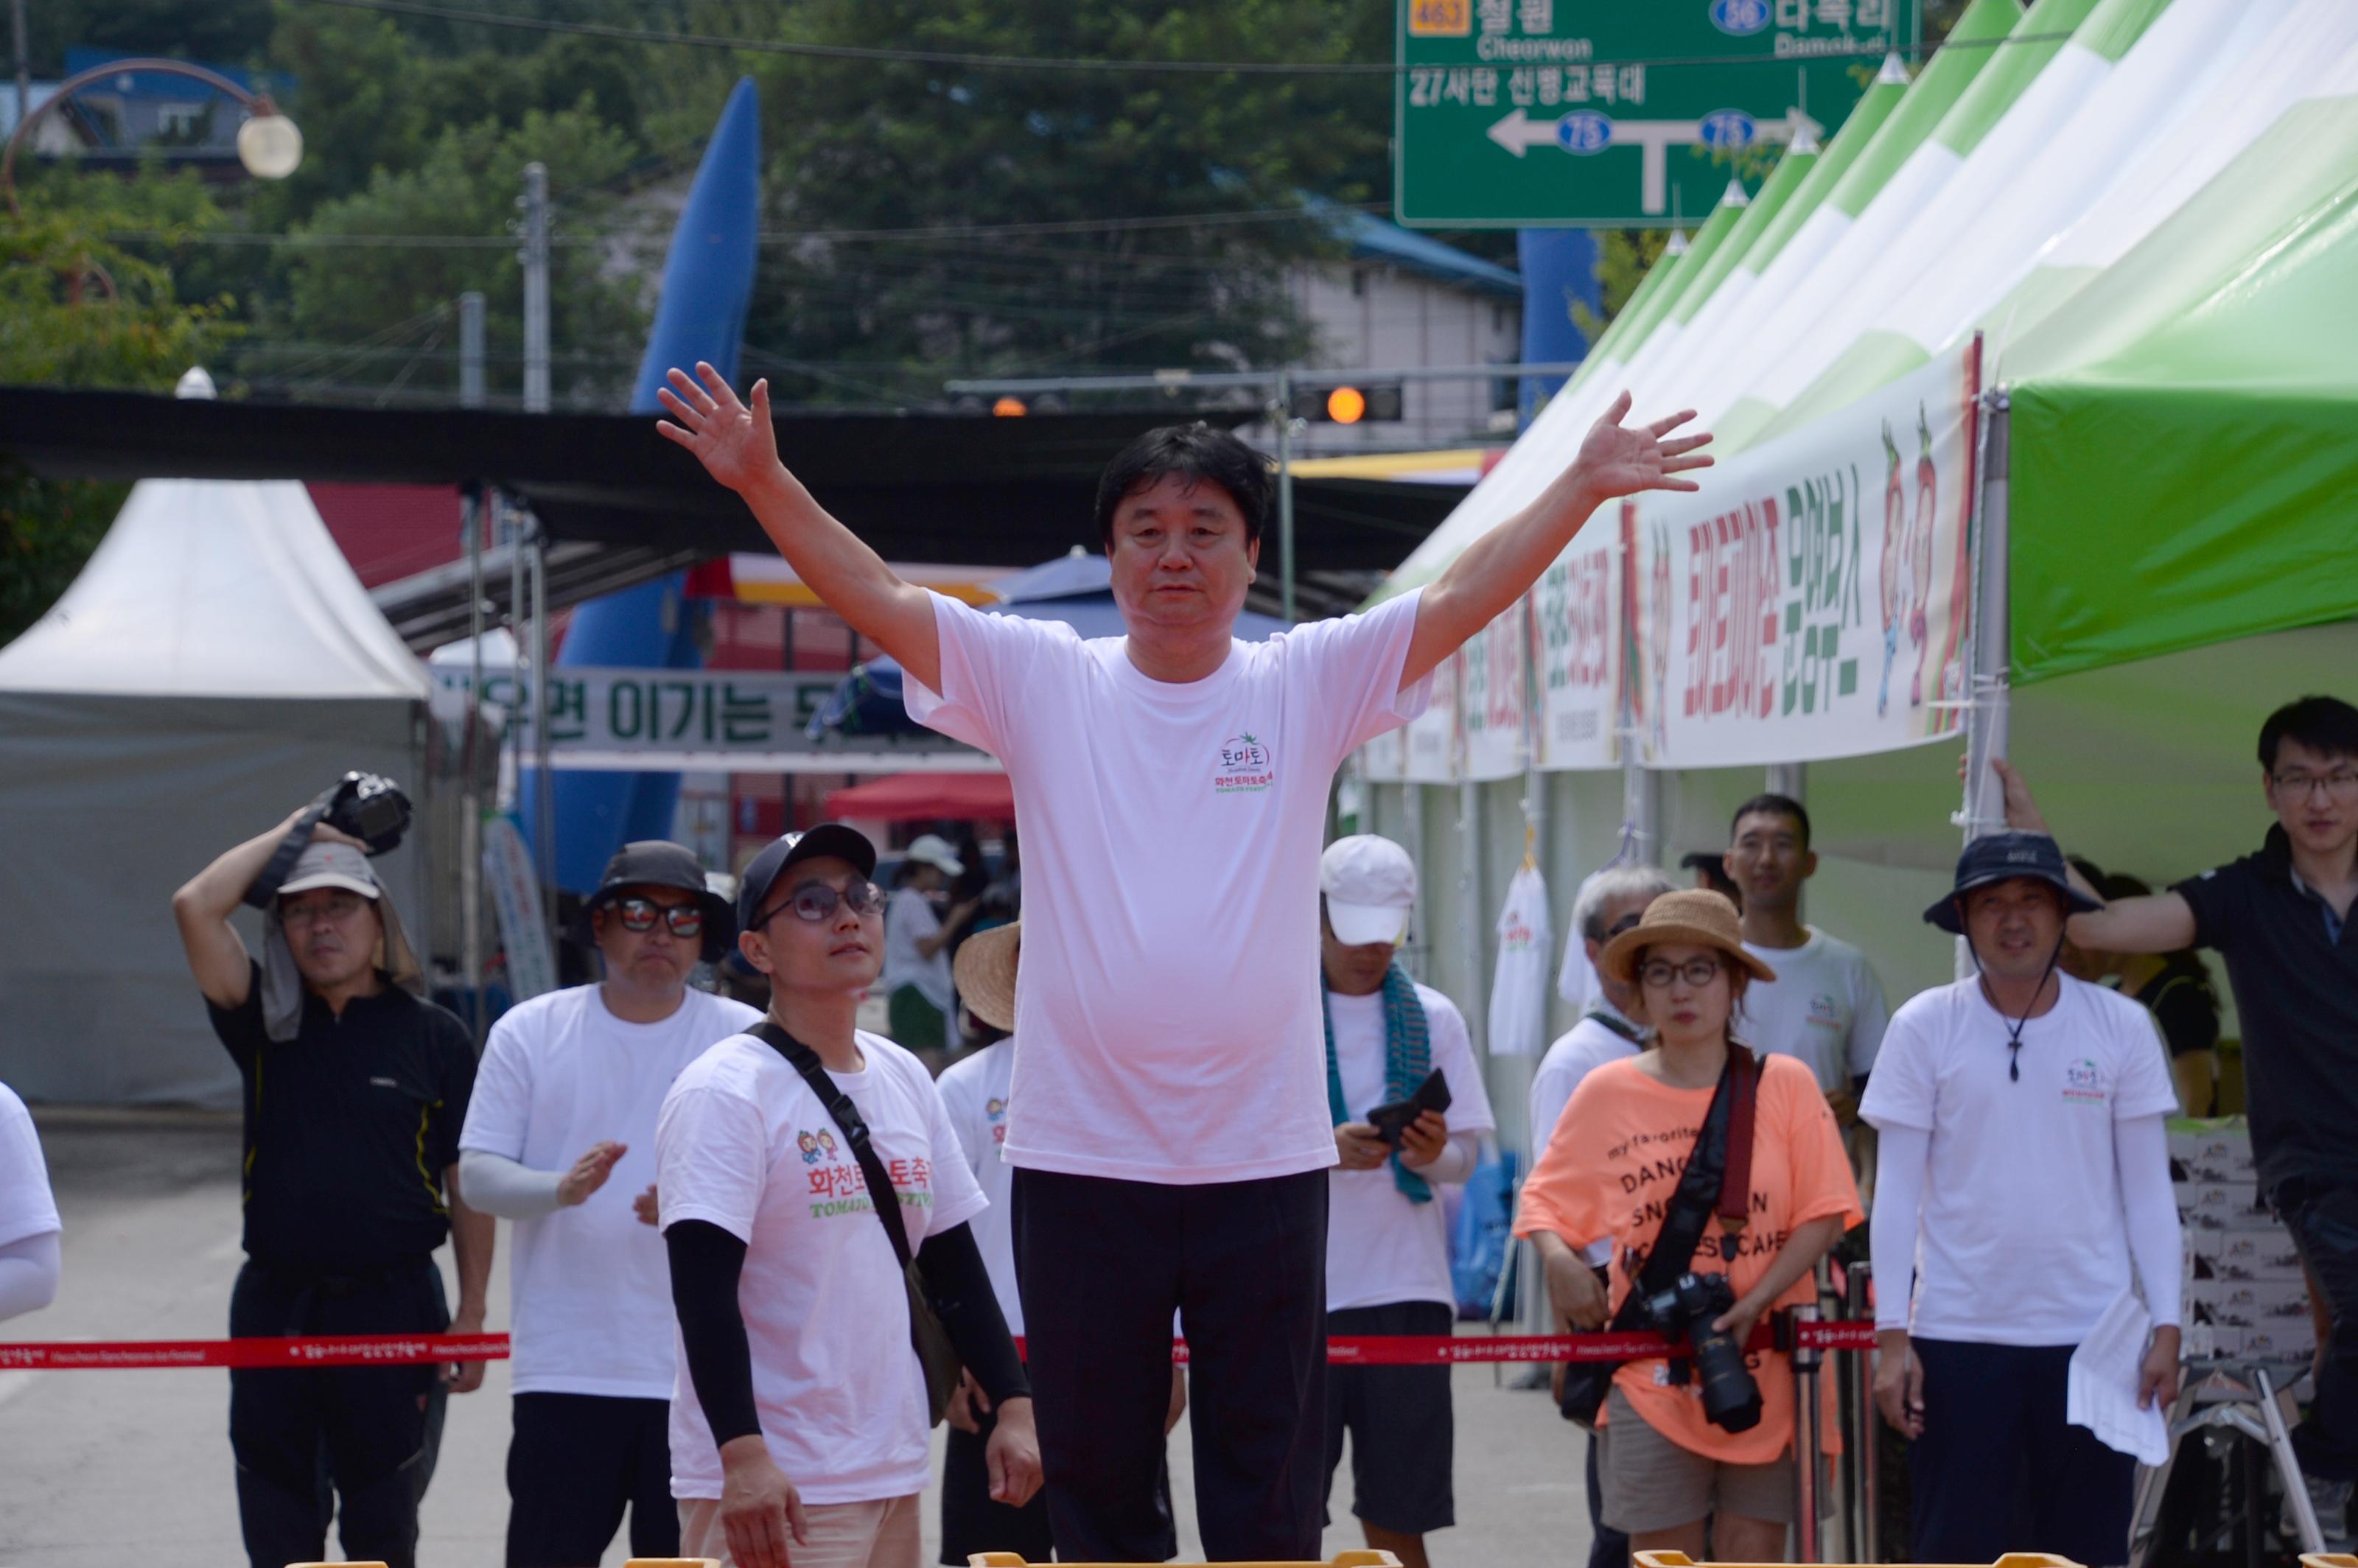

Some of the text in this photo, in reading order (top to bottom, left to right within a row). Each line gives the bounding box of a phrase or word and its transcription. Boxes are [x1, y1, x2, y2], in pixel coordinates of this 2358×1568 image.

[1477, 36, 1593, 60] Cheorwon
[1409, 63, 1499, 106] 27사단
[1566, 115, 1603, 150] 75
[609, 679, 772, 742] 이기는
[1220, 746, 1264, 767] 토마토
[809, 1195, 870, 1218] TOMATO
